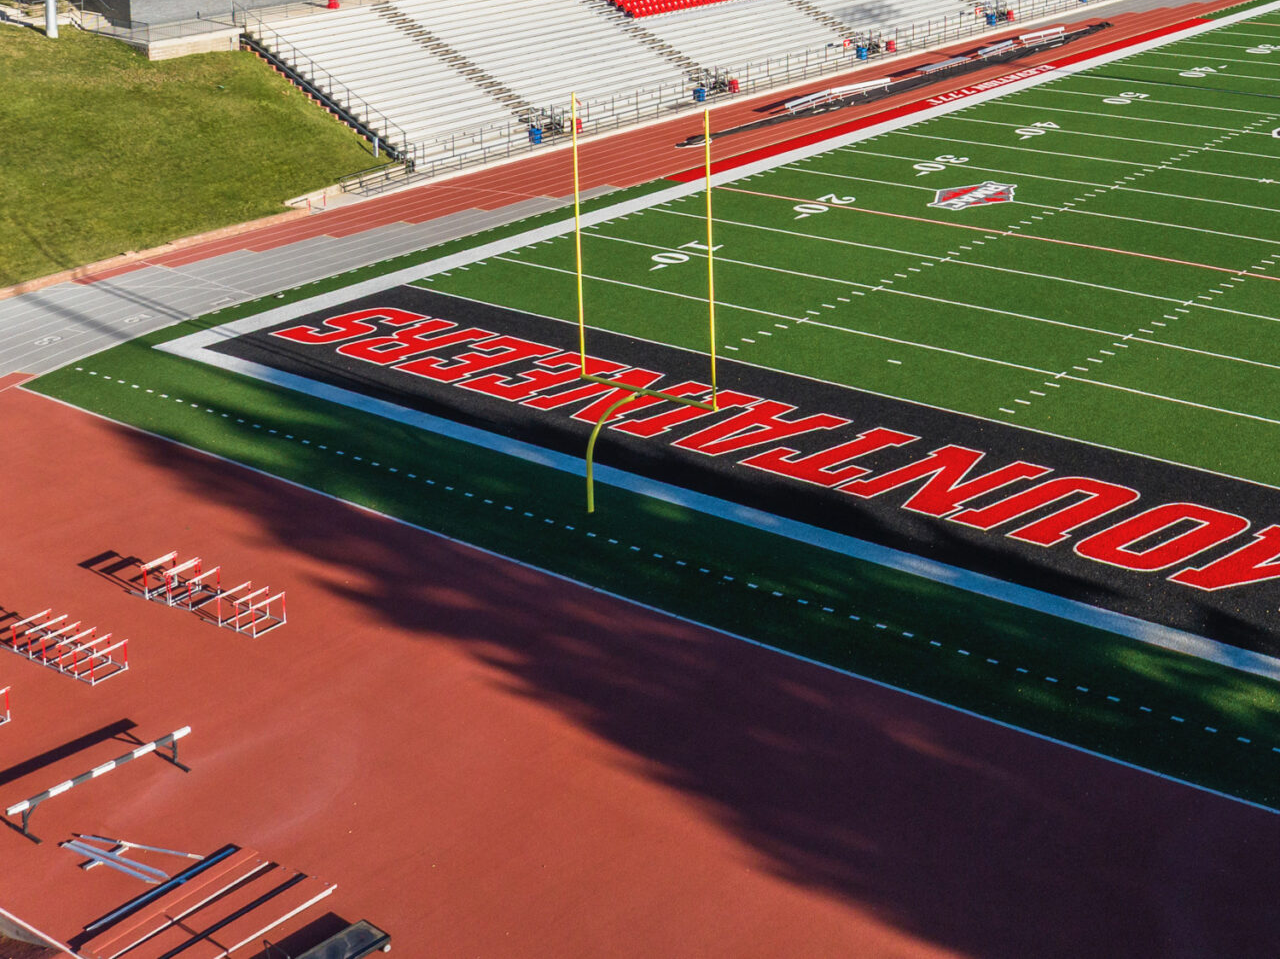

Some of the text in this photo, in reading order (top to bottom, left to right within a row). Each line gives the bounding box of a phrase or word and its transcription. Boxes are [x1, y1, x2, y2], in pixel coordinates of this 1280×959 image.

[972, 64, 1056, 91] ELEVATION
[1102, 91, 1149, 105] 50
[1014, 121, 1060, 136] 40
[913, 154, 969, 172] 30
[793, 193, 856, 214] 20
[651, 240, 724, 264] 10
